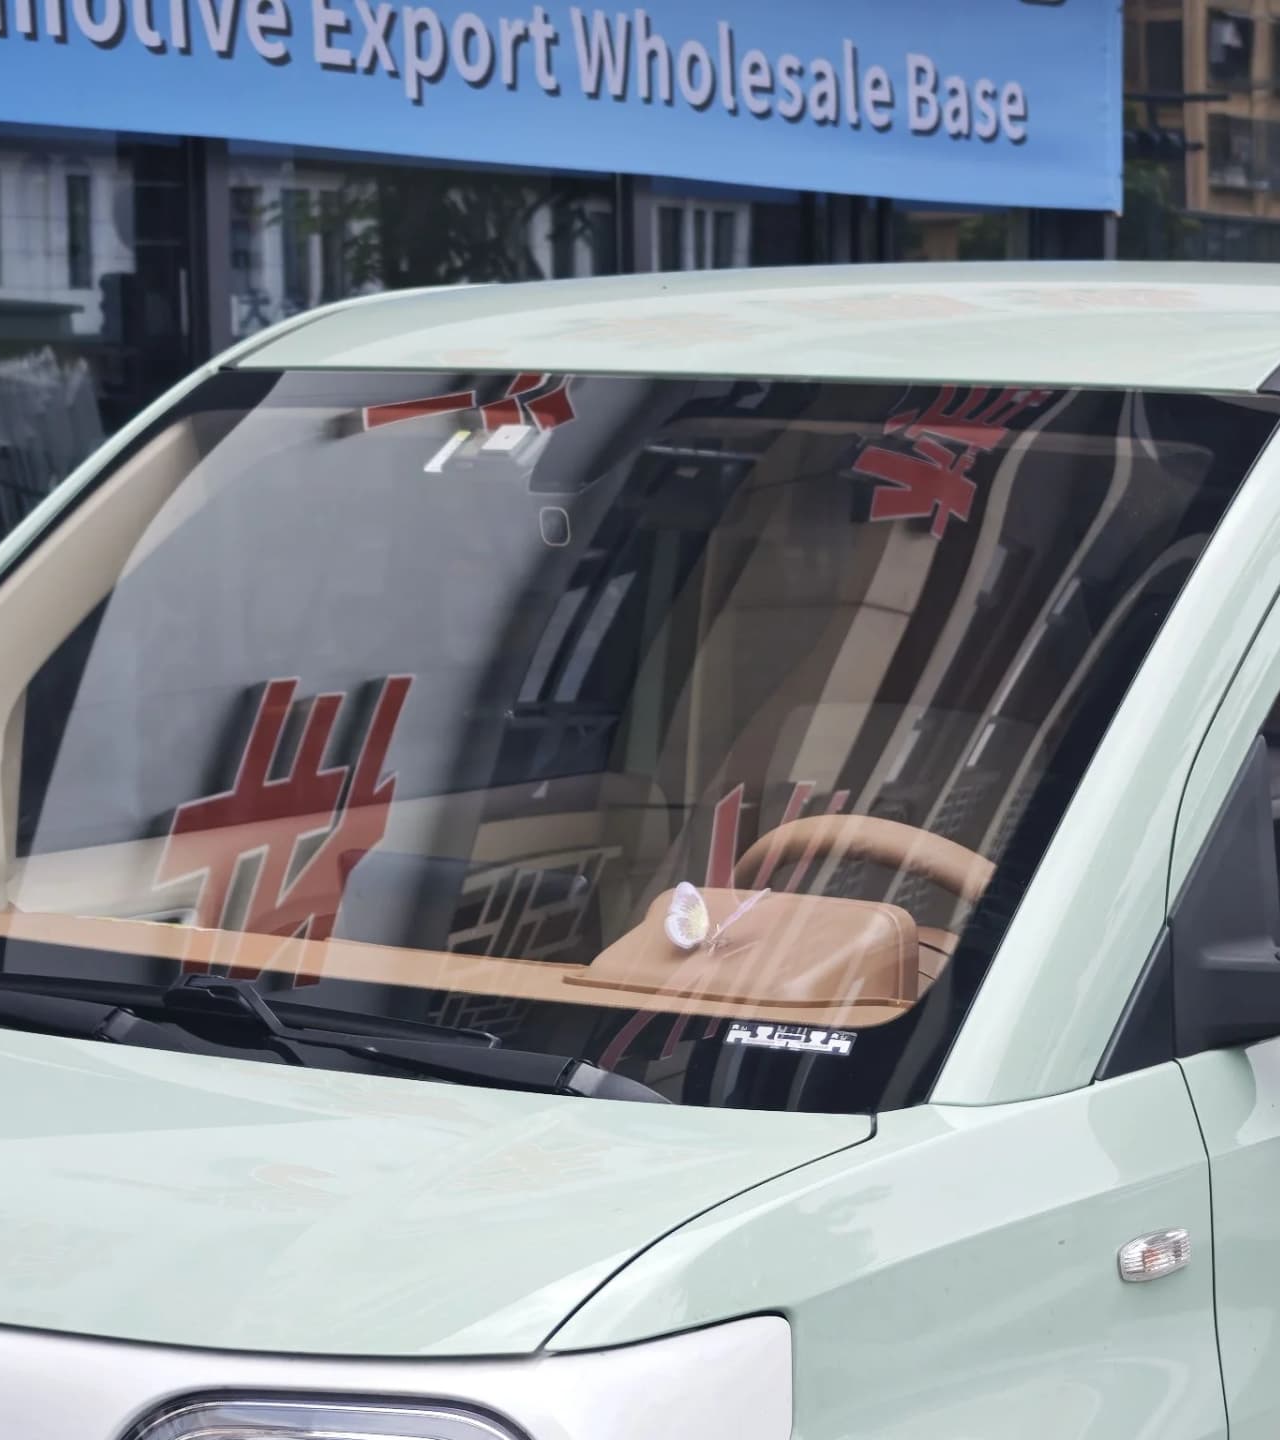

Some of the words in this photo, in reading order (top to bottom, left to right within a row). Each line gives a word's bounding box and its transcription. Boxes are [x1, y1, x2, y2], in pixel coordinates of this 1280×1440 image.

[315, 0, 560, 102] Export
[570, 7, 894, 132] Wholesale
[907, 52, 1028, 144] Base
